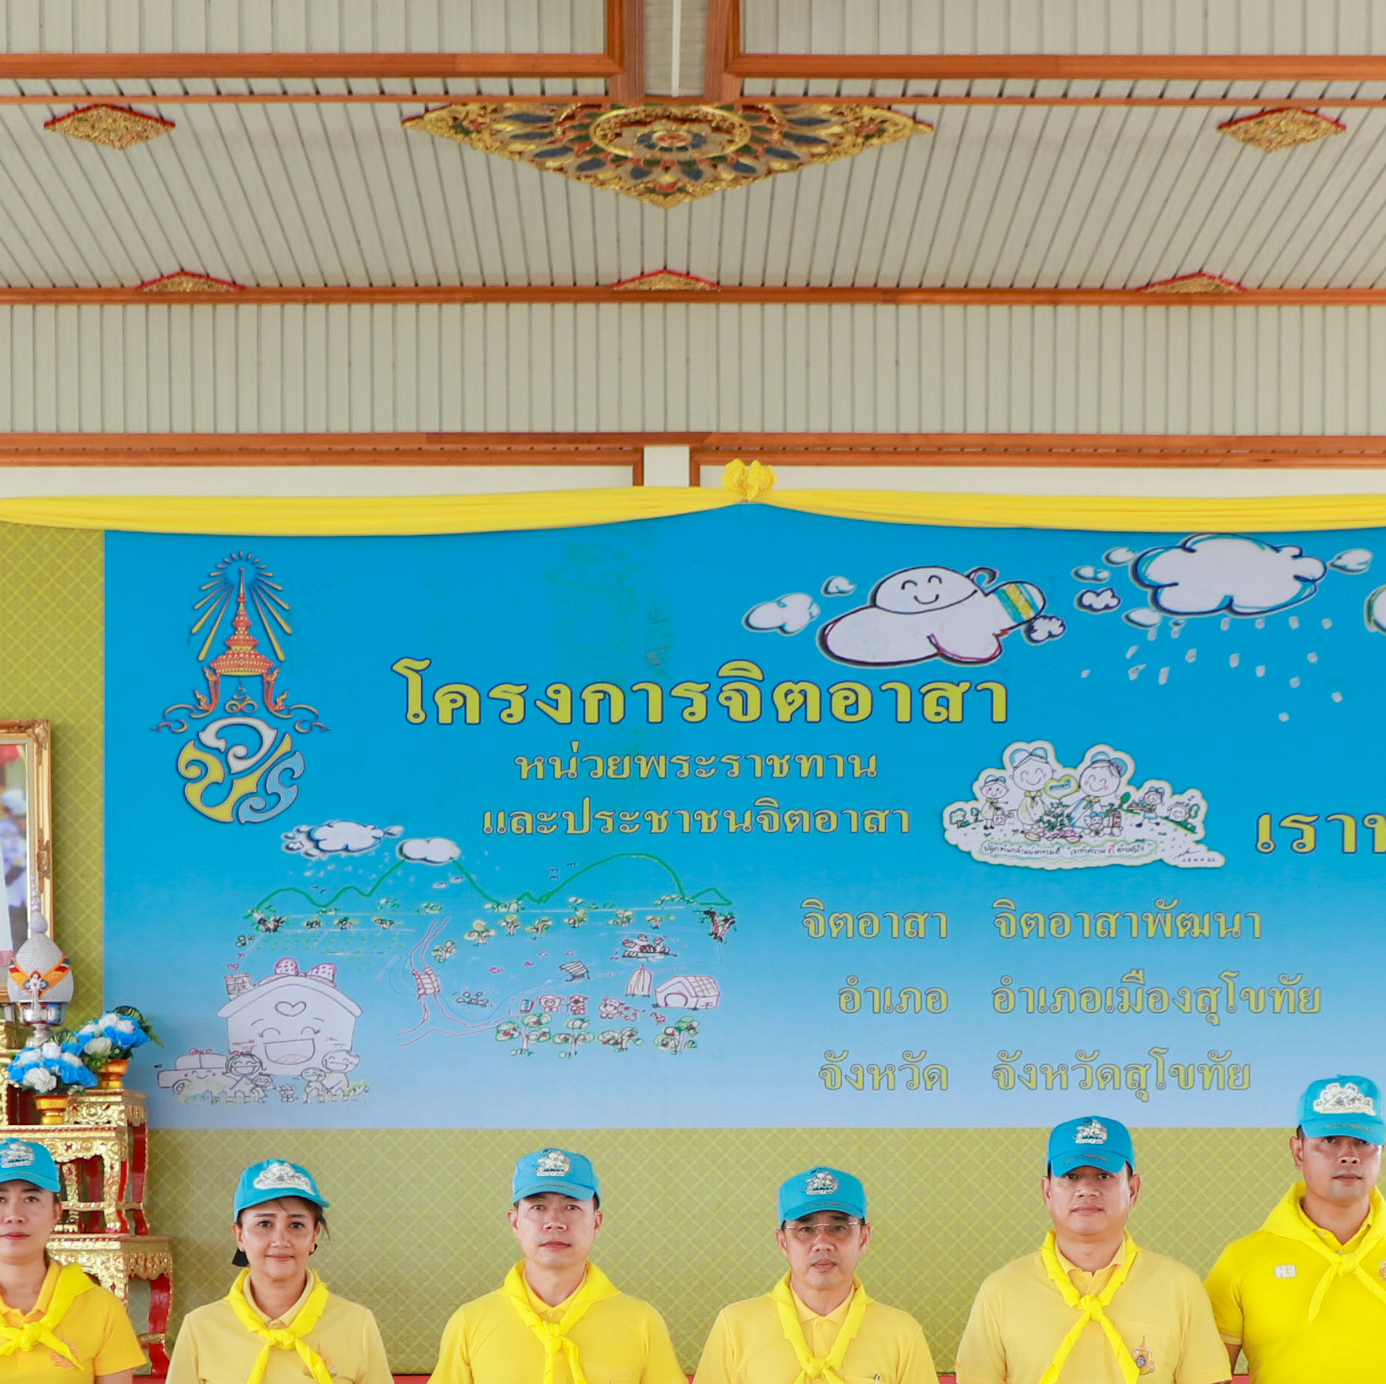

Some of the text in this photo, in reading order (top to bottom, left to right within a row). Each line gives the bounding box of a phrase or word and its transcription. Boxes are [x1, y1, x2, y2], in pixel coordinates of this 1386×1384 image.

[391, 657, 1009, 727] โครงการจิตอาสา
[513, 740, 879, 781] หน่วยพระราชทาน
[481, 796, 912, 837] และประชาชนจิตอาสา
[800, 897, 1264, 942] จิตอาสา จิตอาสาพัฒนา
[837, 968, 1322, 1028] อำเภอ อำเภอเมืองสุโขทัย
[818, 1047, 1253, 1103] จังหวัด จังหวัดสุโขทัย
